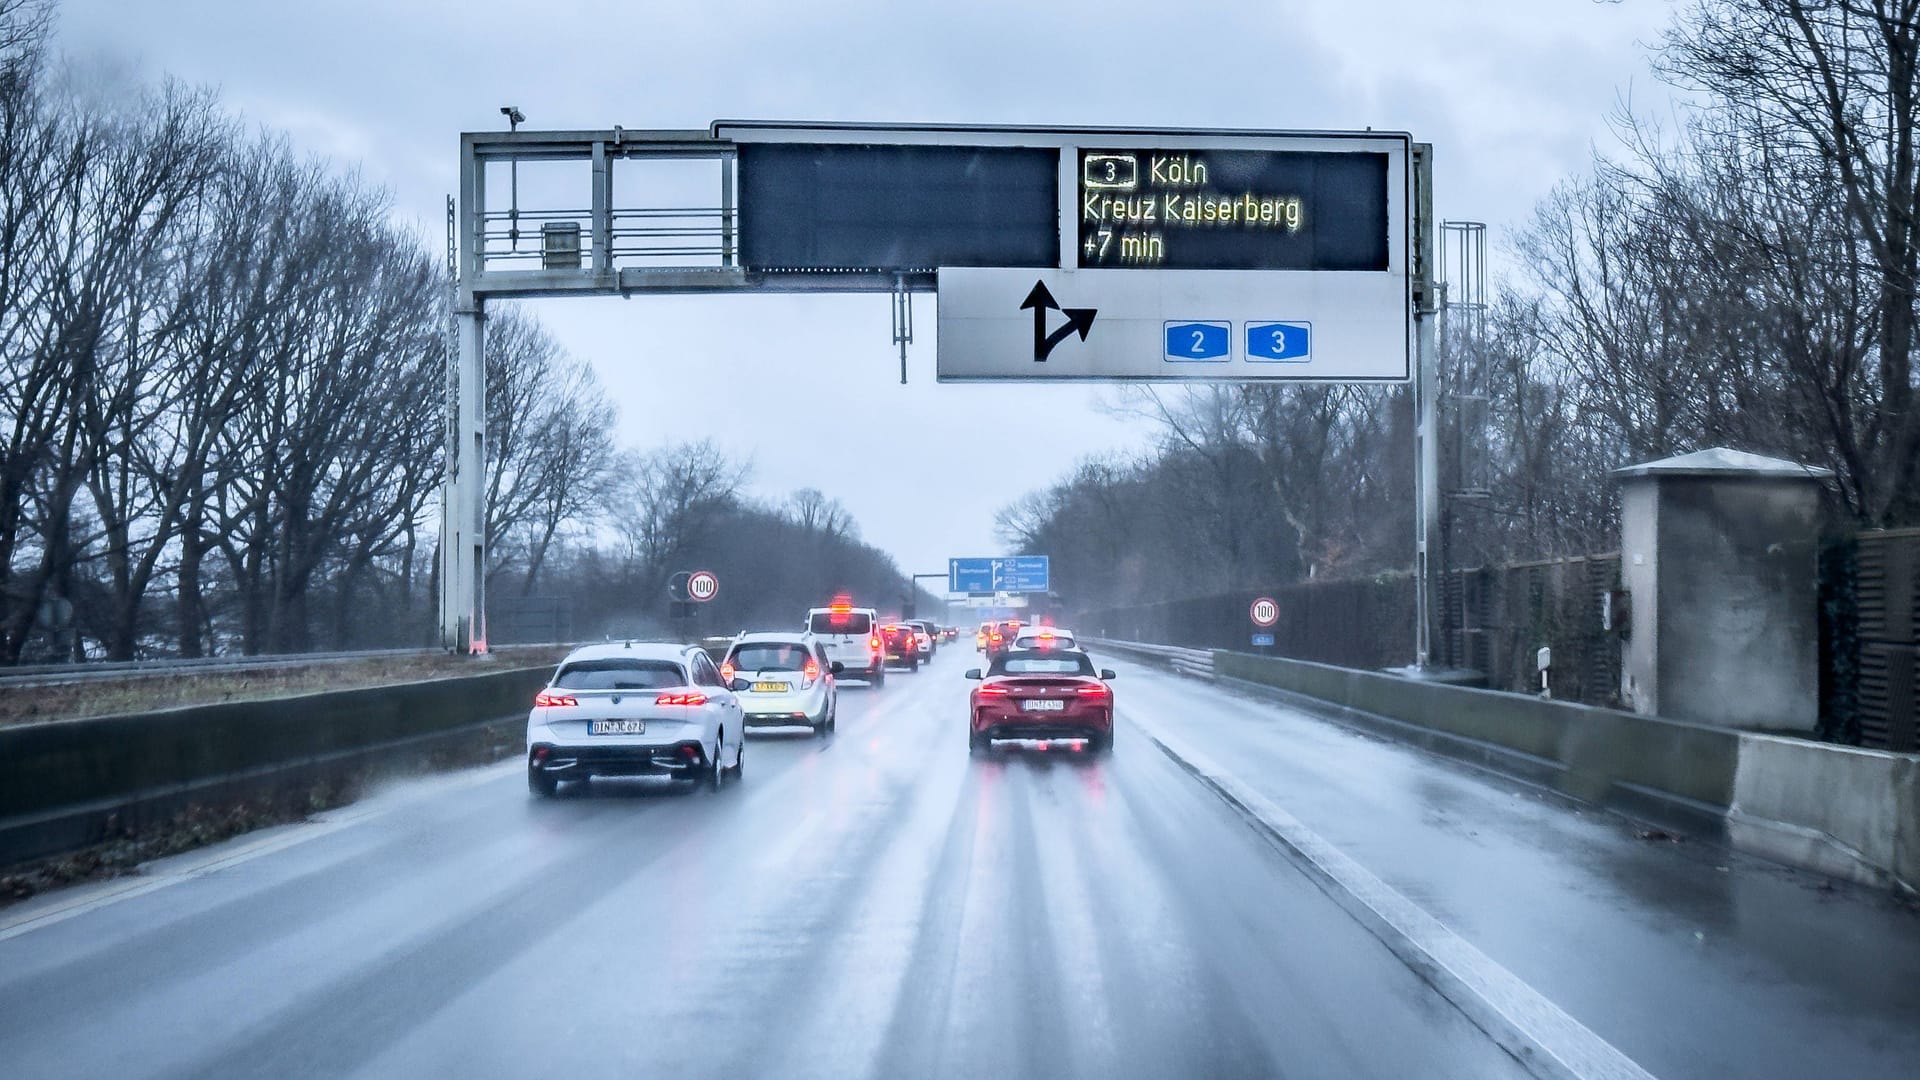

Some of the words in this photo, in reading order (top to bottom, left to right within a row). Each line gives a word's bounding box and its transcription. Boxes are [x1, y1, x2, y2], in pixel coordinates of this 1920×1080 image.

[1105, 161, 1116, 182] 3
[1151, 157, 1206, 183] Köln
[1084, 193, 1156, 219] Kreuz
[1165, 193, 1299, 228] Kaiserberg
[1084, 231, 1112, 257] +7
[1121, 232, 1163, 257] min
[1191, 330, 1205, 353] 2
[1271, 330, 1285, 353] 3
[695, 580, 713, 593] 100
[1257, 605, 1273, 618] 100
